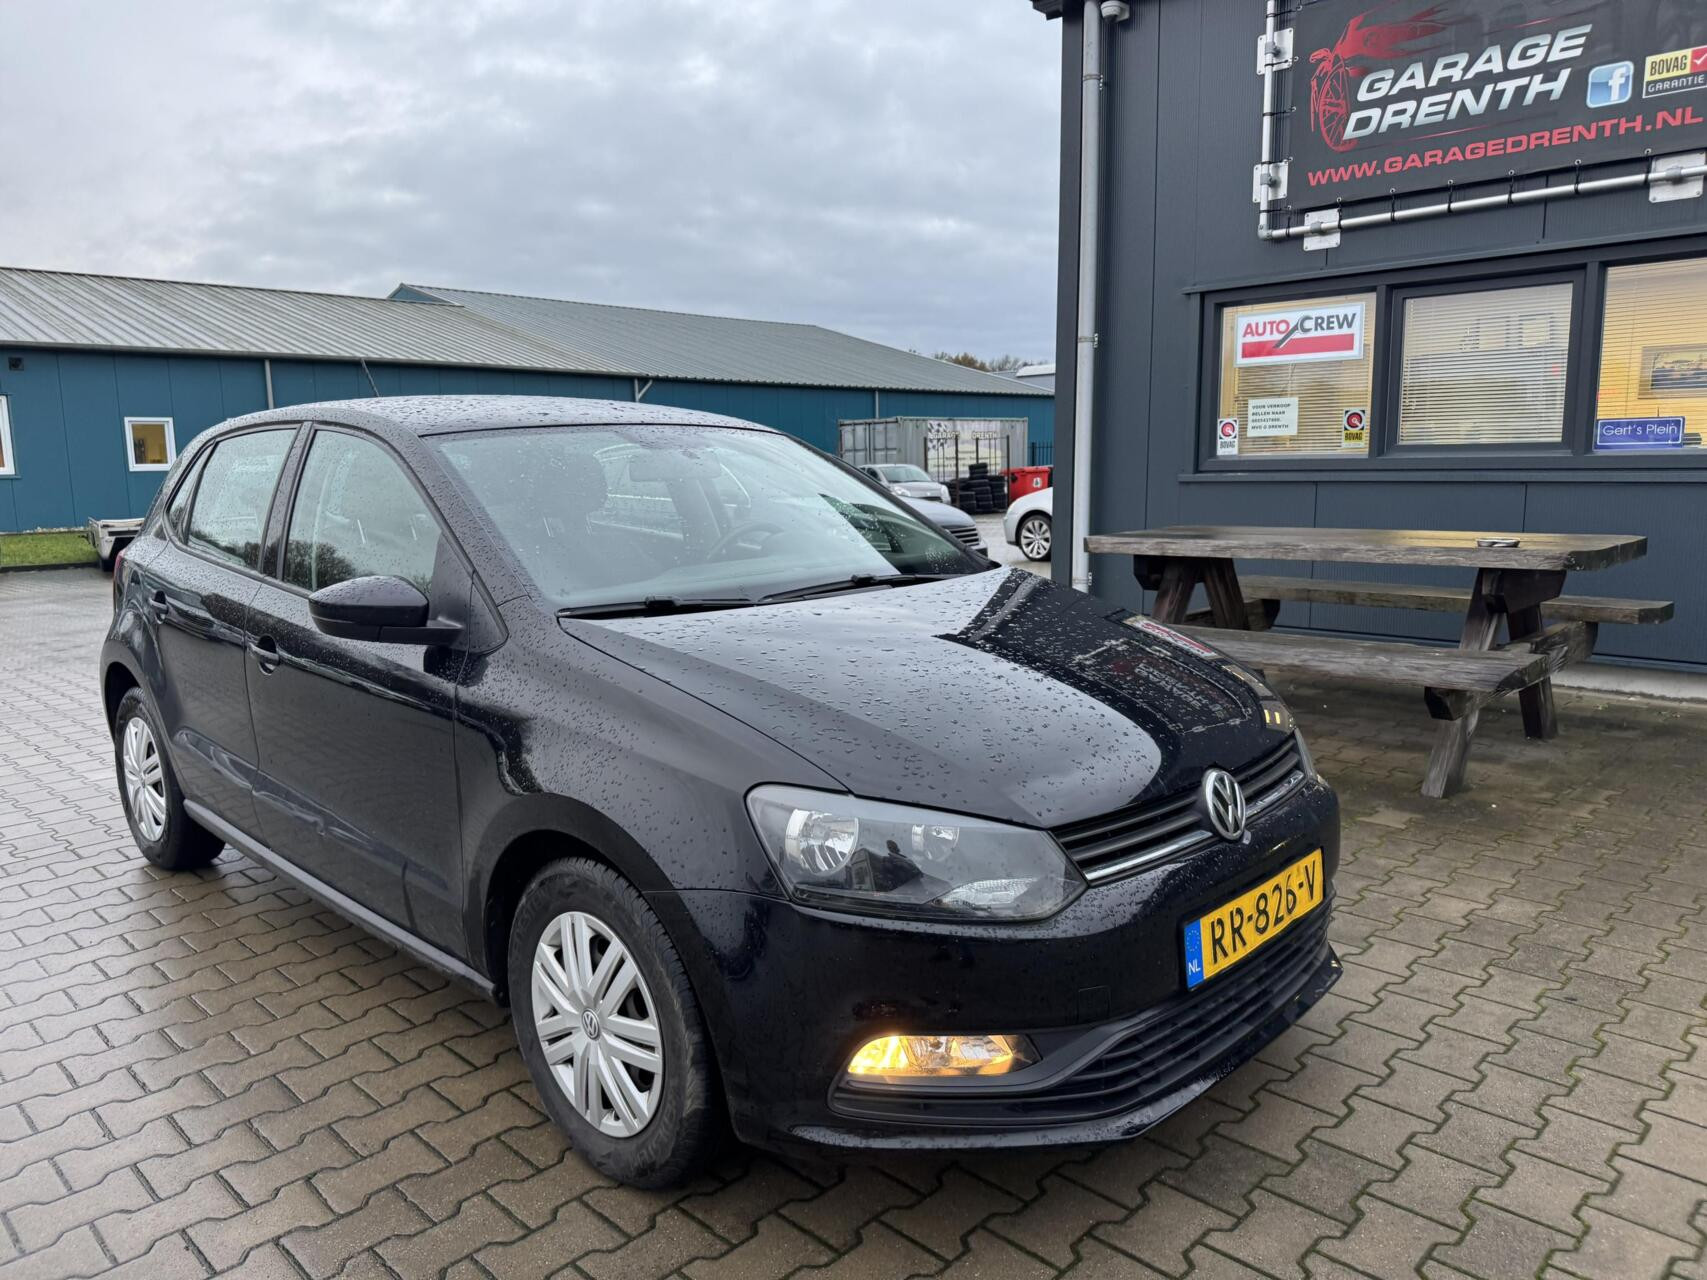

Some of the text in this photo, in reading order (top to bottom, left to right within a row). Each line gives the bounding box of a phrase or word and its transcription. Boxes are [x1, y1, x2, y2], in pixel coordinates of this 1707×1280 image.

[1357, 24, 1593, 102] GARAGE
[1649, 54, 1688, 77] BOVAG
[1647, 74, 1705, 93] GARANTIE
[1342, 68, 1571, 141] DRENTH
[1307, 106, 1704, 187] WWW.GARAGEDRENTH.NL
[1242, 312, 1357, 338] AUTO CREW
[1345, 431, 1363, 441] BOVAG
[1602, 422, 1678, 436] Gert's Plein
[1210, 860, 1316, 965] RR-826-V
[1188, 963, 1201, 976] NL
